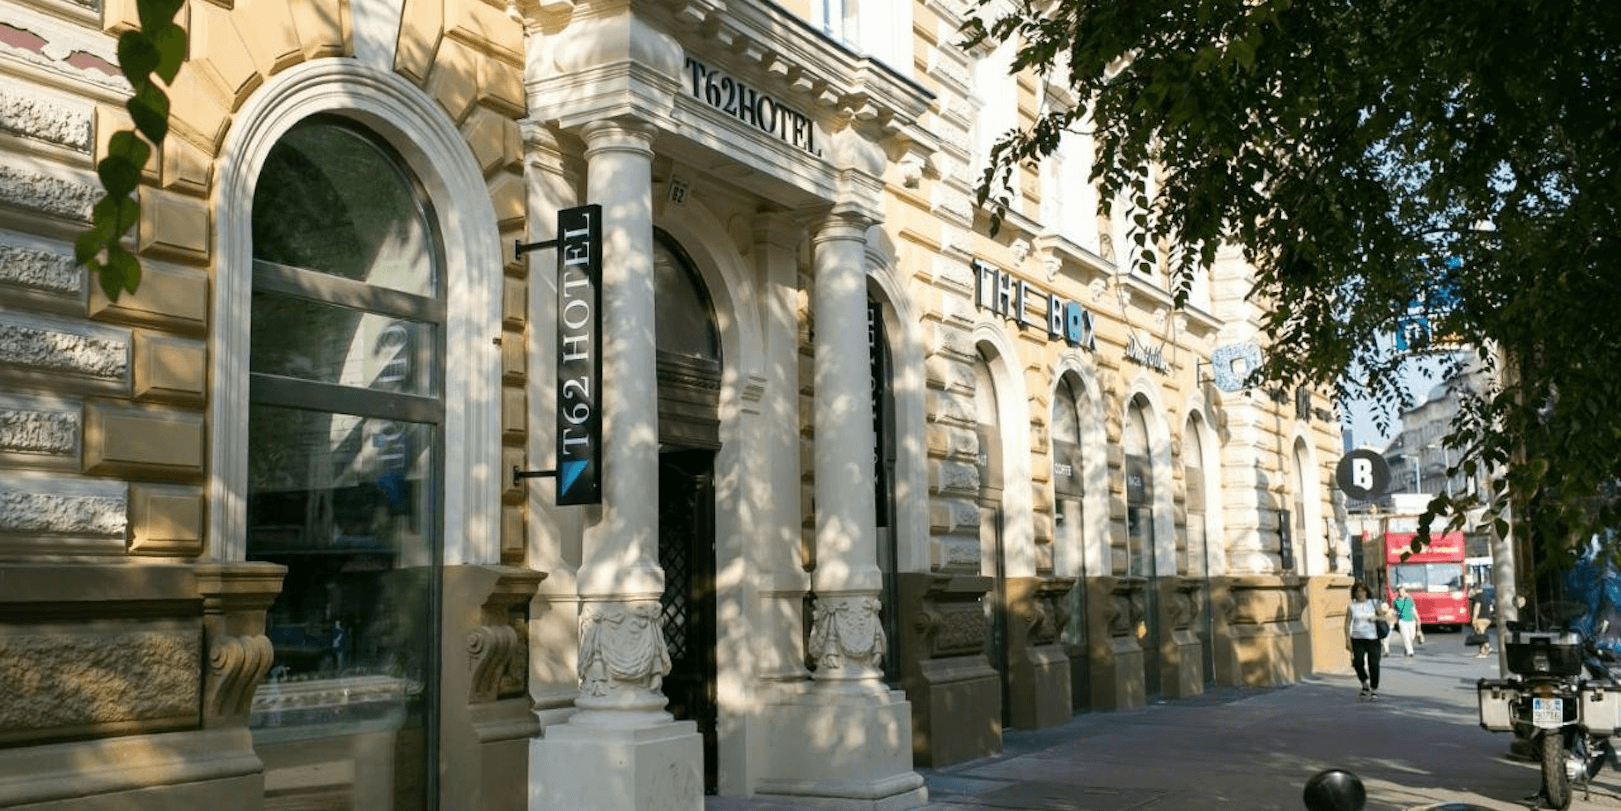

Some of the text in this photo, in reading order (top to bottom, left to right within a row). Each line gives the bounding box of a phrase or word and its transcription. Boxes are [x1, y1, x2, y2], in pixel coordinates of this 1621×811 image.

[686, 57, 822, 157] T62HOTEL
[562, 212, 590, 455] T62 HOTEL
[971, 257, 1095, 350] THE BOX
[1352, 457, 1374, 491] B
